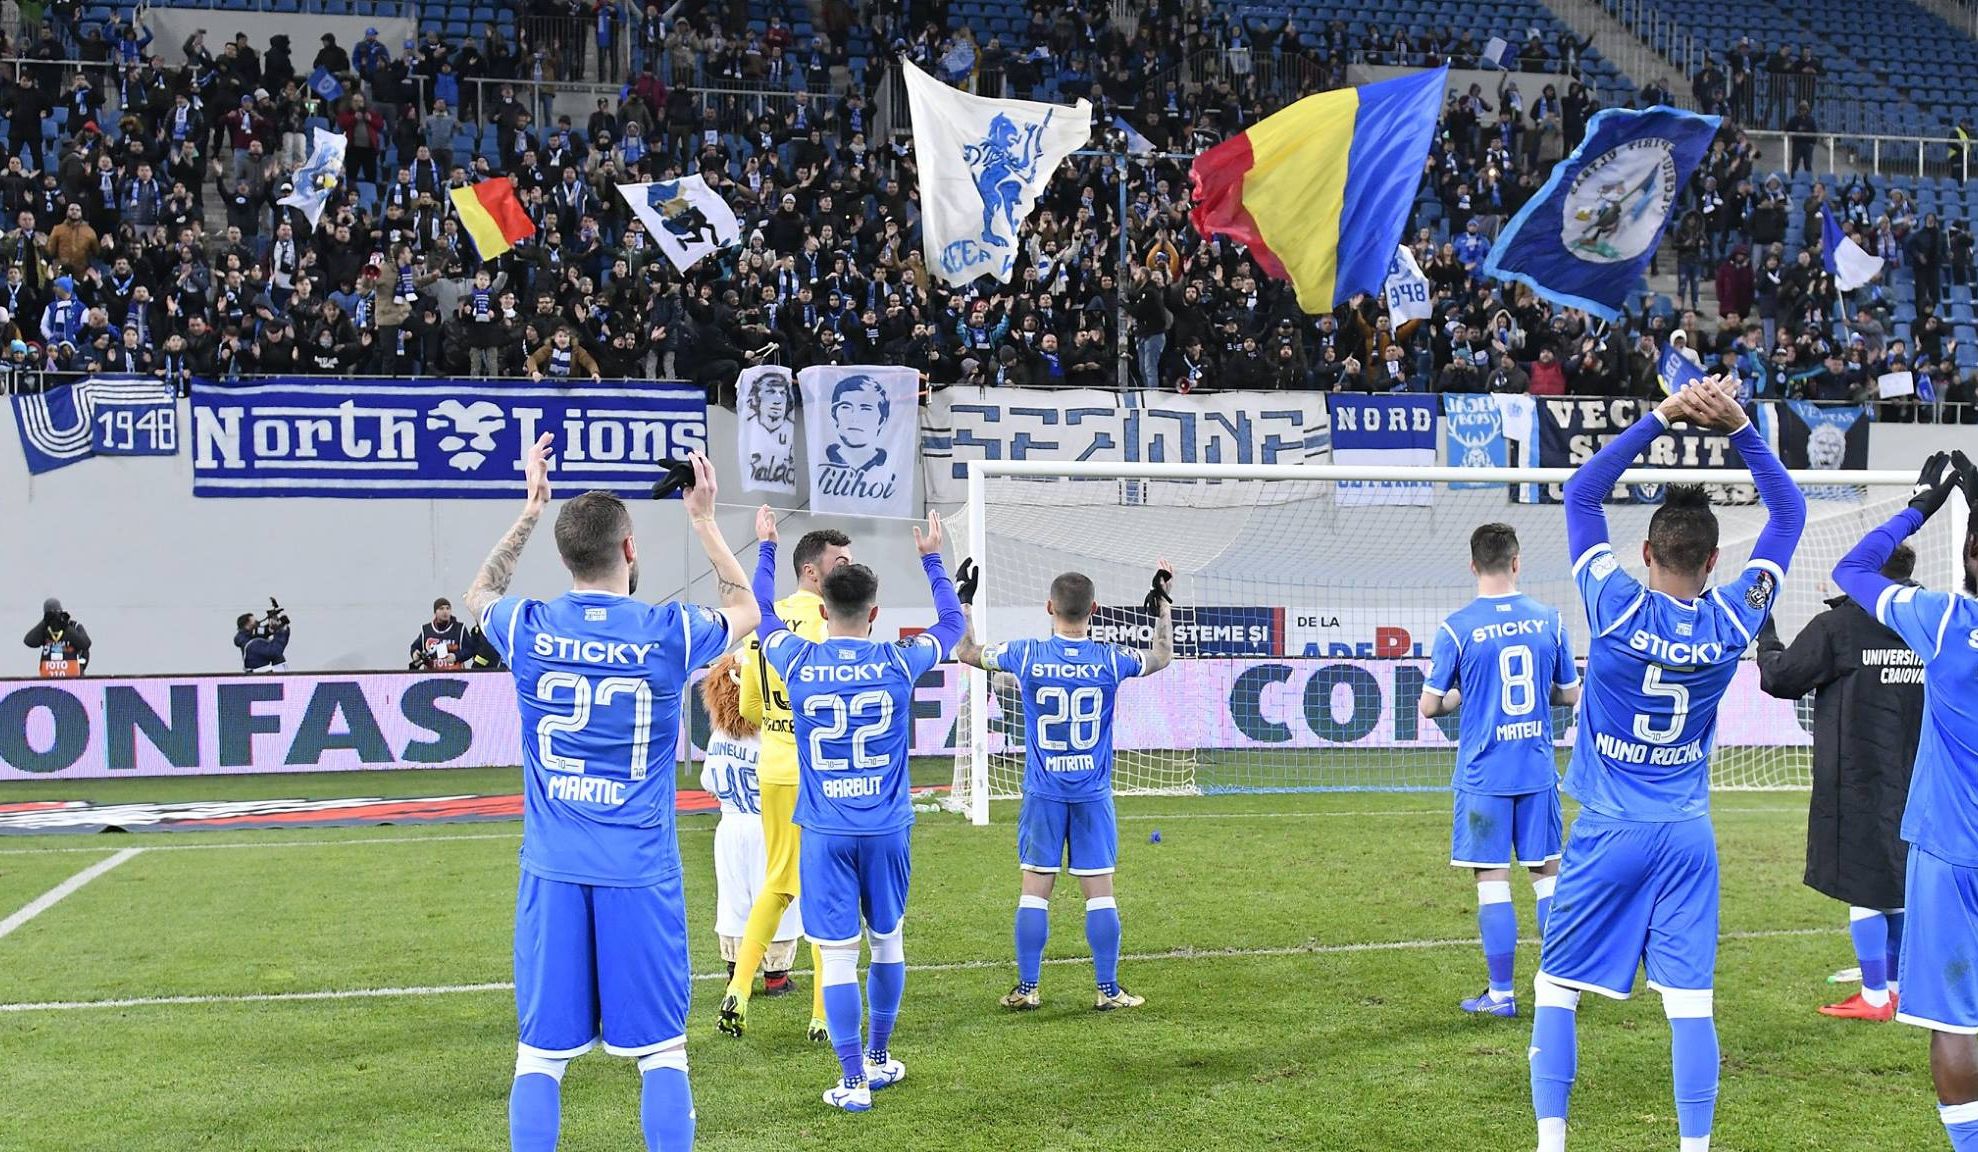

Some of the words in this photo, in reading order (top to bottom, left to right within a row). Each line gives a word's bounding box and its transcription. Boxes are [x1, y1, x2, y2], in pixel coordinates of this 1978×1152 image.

[97, 408, 176, 449] 1948
[1336, 407, 1432, 432] NORD
[193, 399, 417, 468] North
[511, 407, 708, 472] Lions
[1569, 434, 1730, 466] SRIT
[1297, 616, 1317, 628] DE
[1321, 616, 1340, 628] LA
[1472, 619, 1543, 643] STICKY
[534, 633, 652, 664] STICKY
[1629, 629, 1723, 665] STICKY
[800, 663, 887, 682] STICKY
[1031, 663, 1102, 678] STICKY
[1499, 645, 1536, 716] 8
[1880, 667, 1925, 684] CRAIOVA
[1632, 661, 1696, 744] 5
[0, 678, 473, 773] ONFAS
[536, 671, 653, 780] 27
[803, 690, 893, 771] 22
[1036, 686, 1104, 751] 28
[1496, 720, 1542, 741] MATEU
[1045, 754, 1095, 772] MITRITA
[1595, 732, 1647, 764] NUNO
[549, 775, 626, 806] MARTIC
[822, 776, 884, 798] BARBUT
